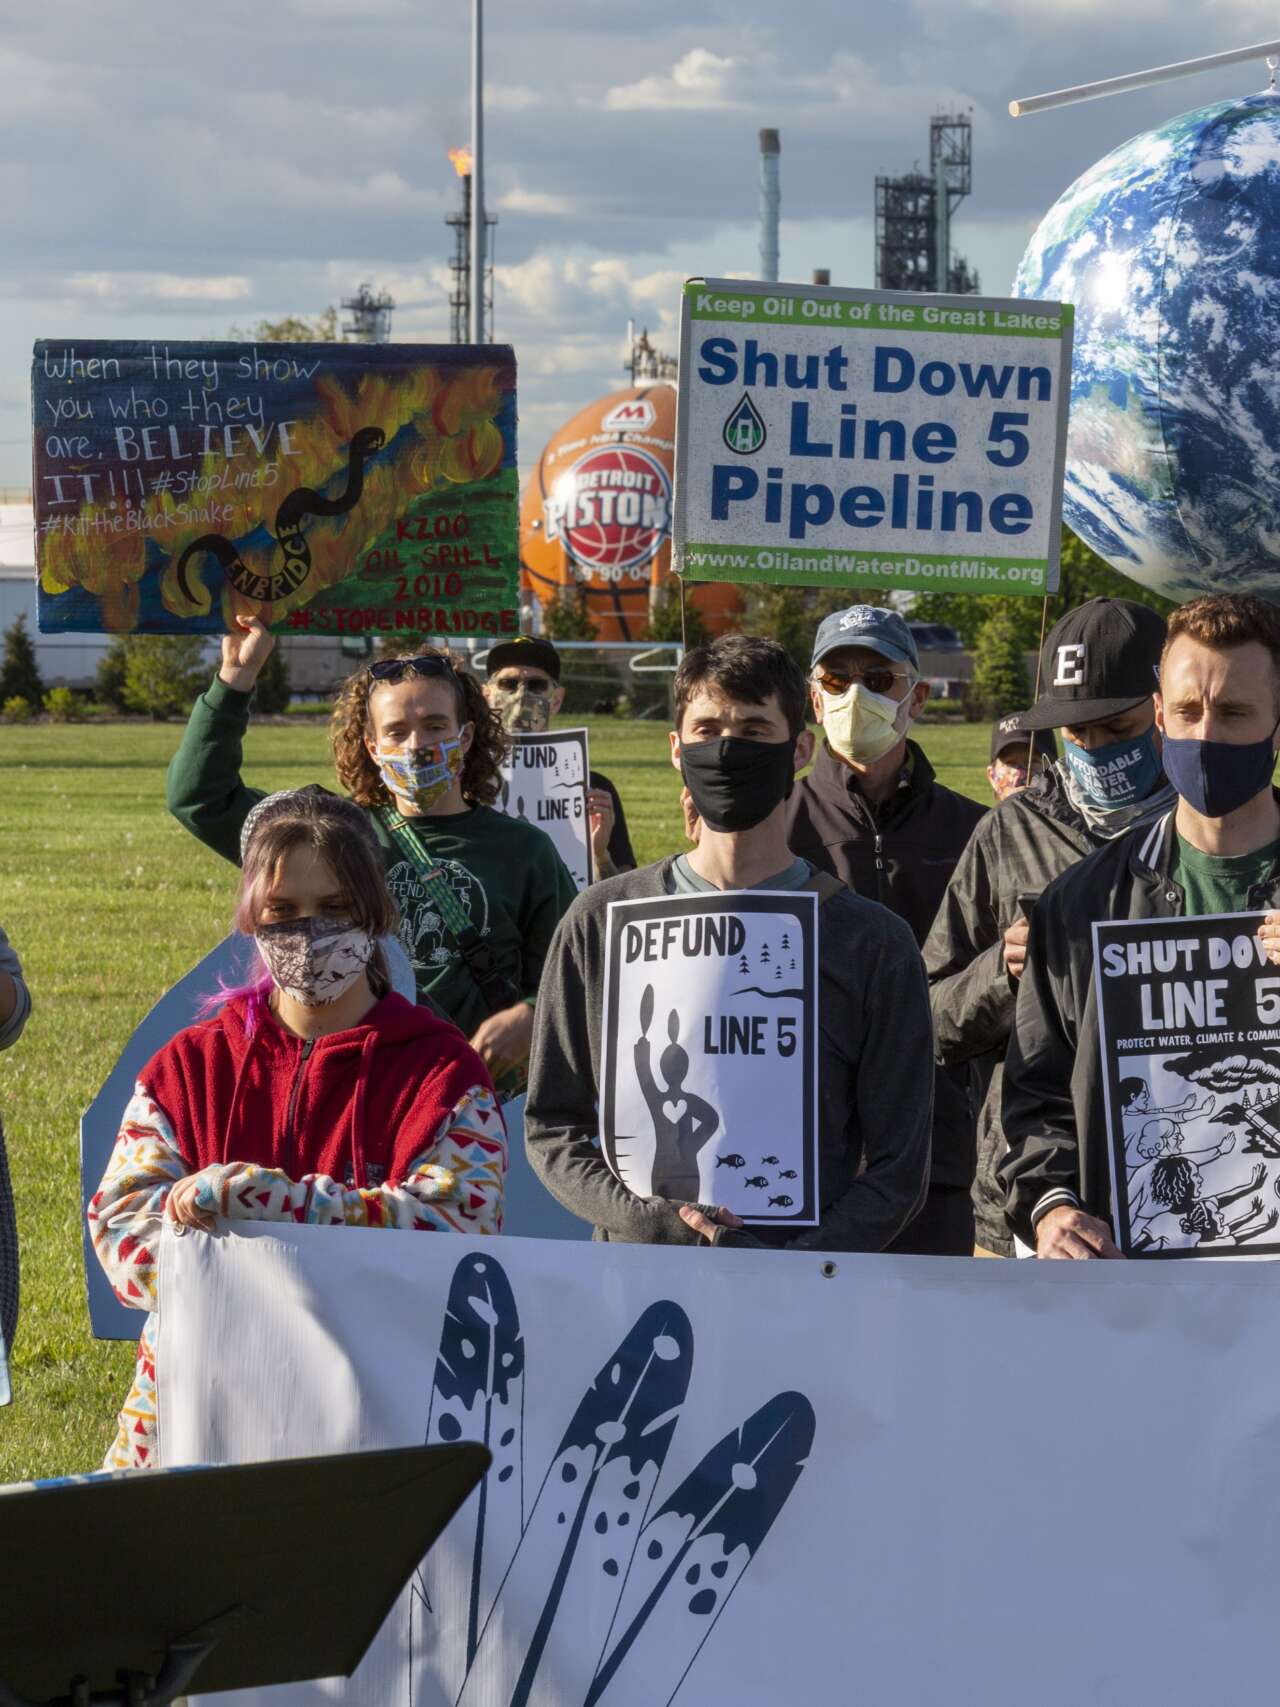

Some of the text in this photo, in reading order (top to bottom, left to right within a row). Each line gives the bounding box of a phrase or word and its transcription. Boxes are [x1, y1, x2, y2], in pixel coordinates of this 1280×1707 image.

[697, 294, 1061, 330] Keep Oil Out of the Great Lakes
[44, 346, 320, 391] When they show
[698, 337, 1052, 401] Shut Down
[45, 387, 264, 432] you who they
[115, 421, 303, 461] BELIEVE
[789, 400, 1030, 467] Line 5
[43, 463, 279, 510] IT!!! #StopLine5
[710, 464, 1034, 541] Pipeline
[40, 501, 234, 537] #KilltheBlackSnake
[396, 513, 470, 542] KZOO
[544, 489, 673, 542] PISTON
[225, 524, 308, 599] ENBRIDGE
[421, 544, 501, 568] SPILL
[689, 551, 1044, 587] www.OilandWaterDontMix.org
[393, 573, 462, 600] 2010
[288, 607, 518, 633] #STOPENBRIDGE
[1053, 643, 1087, 687] E
[1069, 748, 1142, 777] AFFORDABLE
[538, 797, 582, 820] LINE 5
[1110, 781, 1137, 798] ALL
[626, 916, 746, 964] DEFUND
[1103, 935, 1271, 977] SHUT DO
[1141, 979, 1228, 1030] LINE
[704, 1016, 797, 1057] LINE 5
[1117, 1037, 1155, 1049] PROTECT
[1196, 1032, 1234, 1044] CLIMATE
[1238, 1033, 1244, 1041] &
